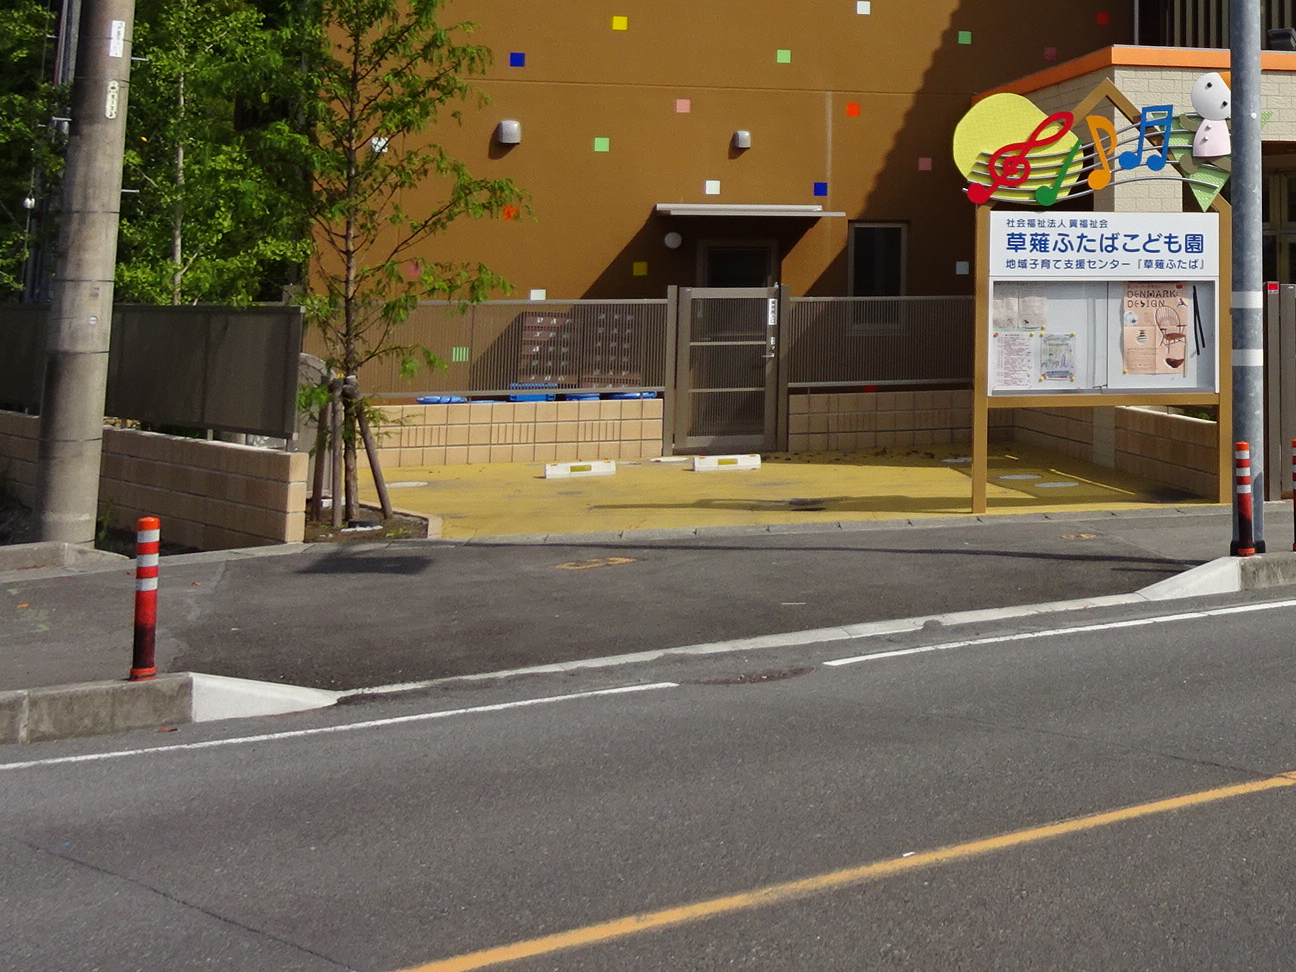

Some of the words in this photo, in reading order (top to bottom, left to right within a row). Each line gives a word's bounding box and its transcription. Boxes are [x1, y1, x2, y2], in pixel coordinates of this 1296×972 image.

[1005, 231, 1204, 254] 草薙ふたばこども園
